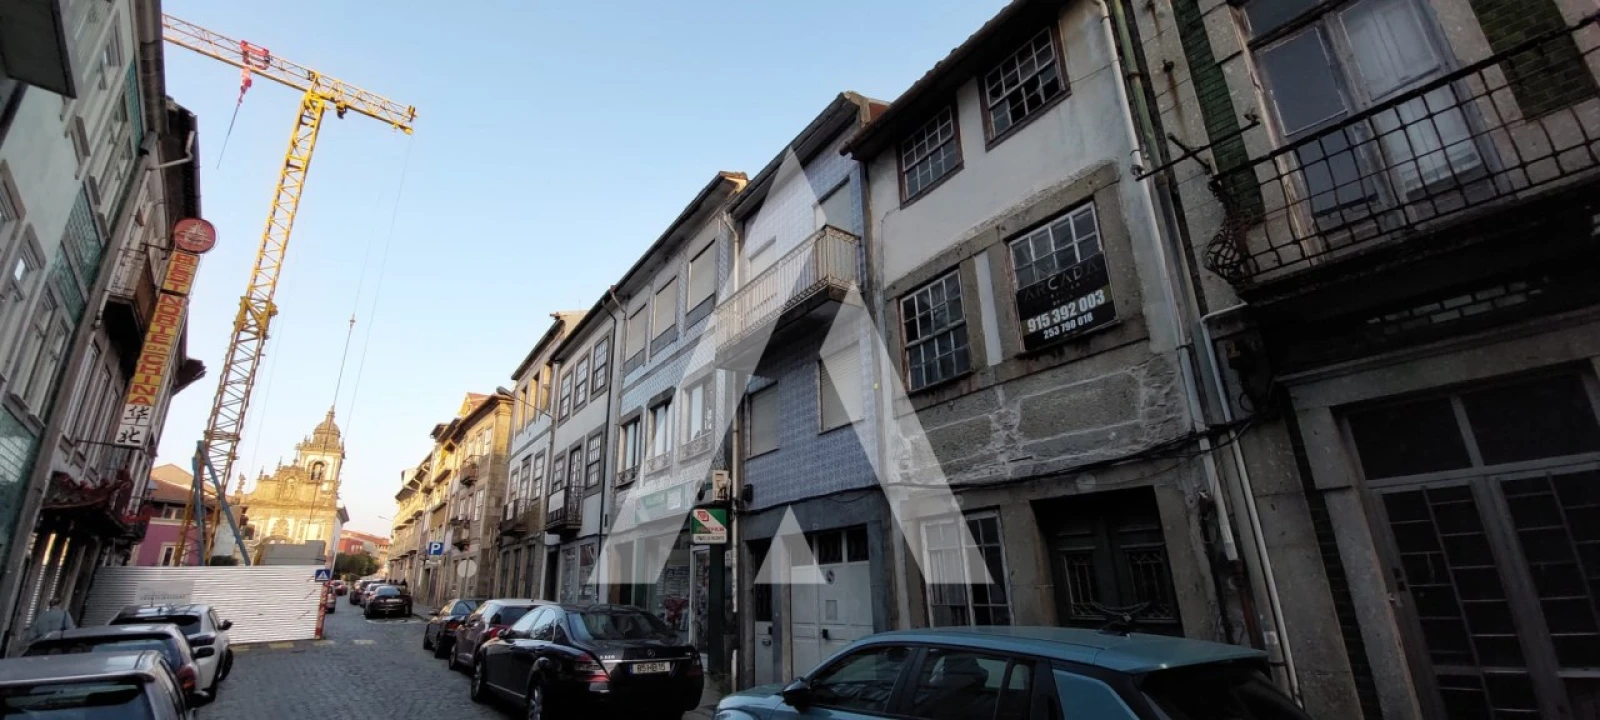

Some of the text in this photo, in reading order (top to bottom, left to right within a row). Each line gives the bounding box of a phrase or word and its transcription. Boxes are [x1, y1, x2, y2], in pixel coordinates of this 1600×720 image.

[1025, 262, 1100, 300] ARCADA
[151, 295, 184, 344] NORTE
[1027, 289, 1105, 332] 915 392 003
[1043, 325, 1060, 340] 253
[1060, 319, 1076, 332] 790
[1078, 312, 1094, 326] 018
[129, 354, 164, 405] CHINA
[117, 405, 150, 443] 华北
[431, 543, 440, 554] P
